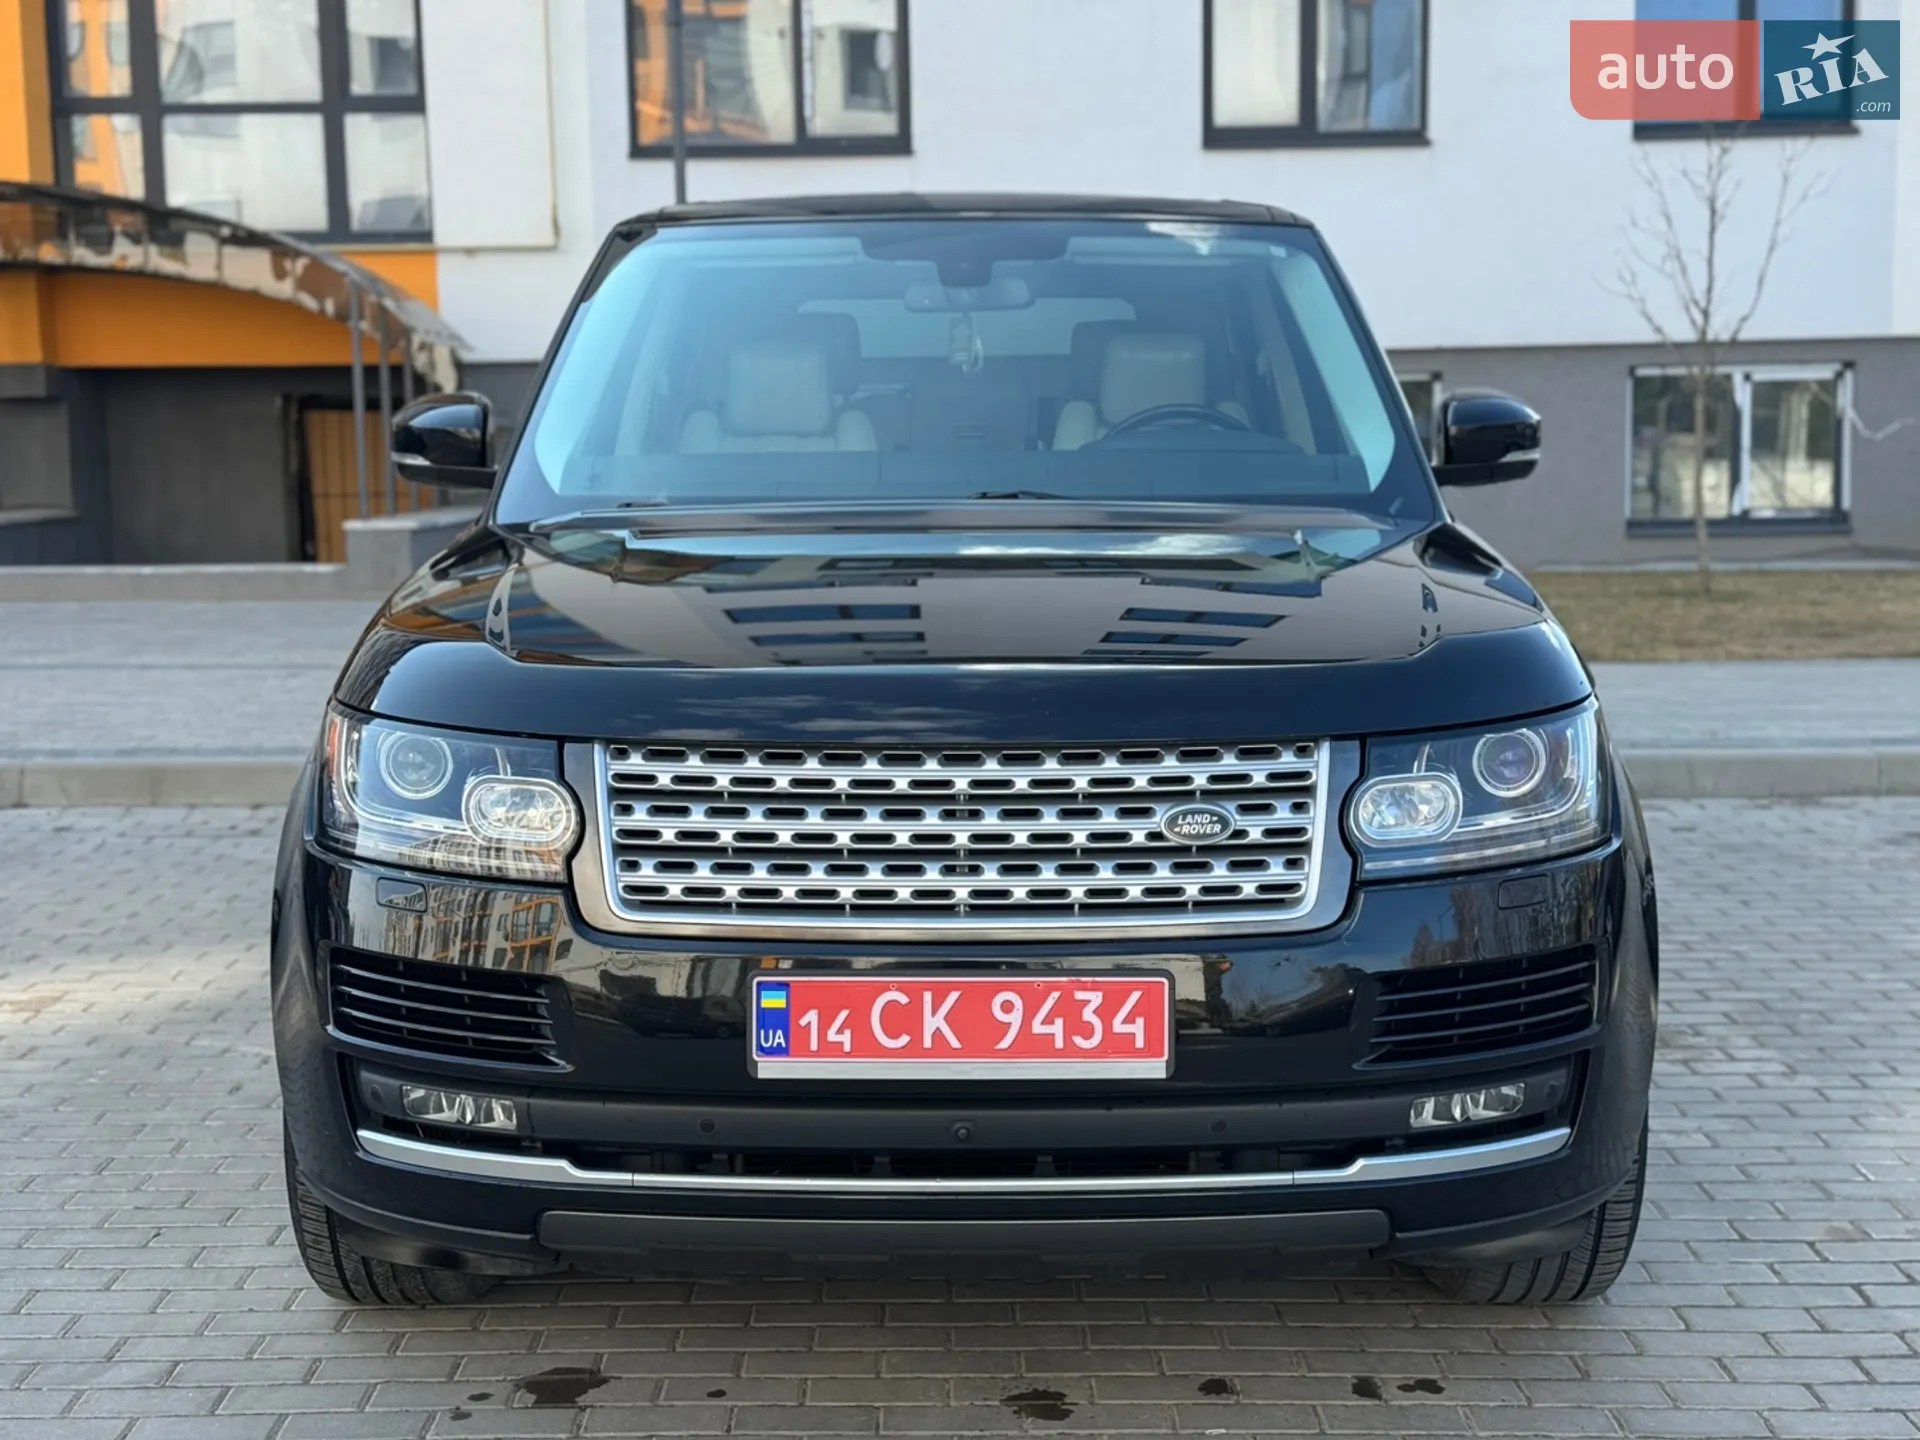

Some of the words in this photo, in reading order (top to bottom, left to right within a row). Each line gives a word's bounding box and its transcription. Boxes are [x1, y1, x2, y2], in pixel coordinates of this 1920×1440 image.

[1177, 813, 1211, 825] LAND
[1180, 823, 1222, 835] ROVER
[798, 1009, 852, 1053] 14
[870, 990, 964, 1049] CK
[991, 990, 1144, 1049] 9434
[760, 1029, 786, 1048] UA
